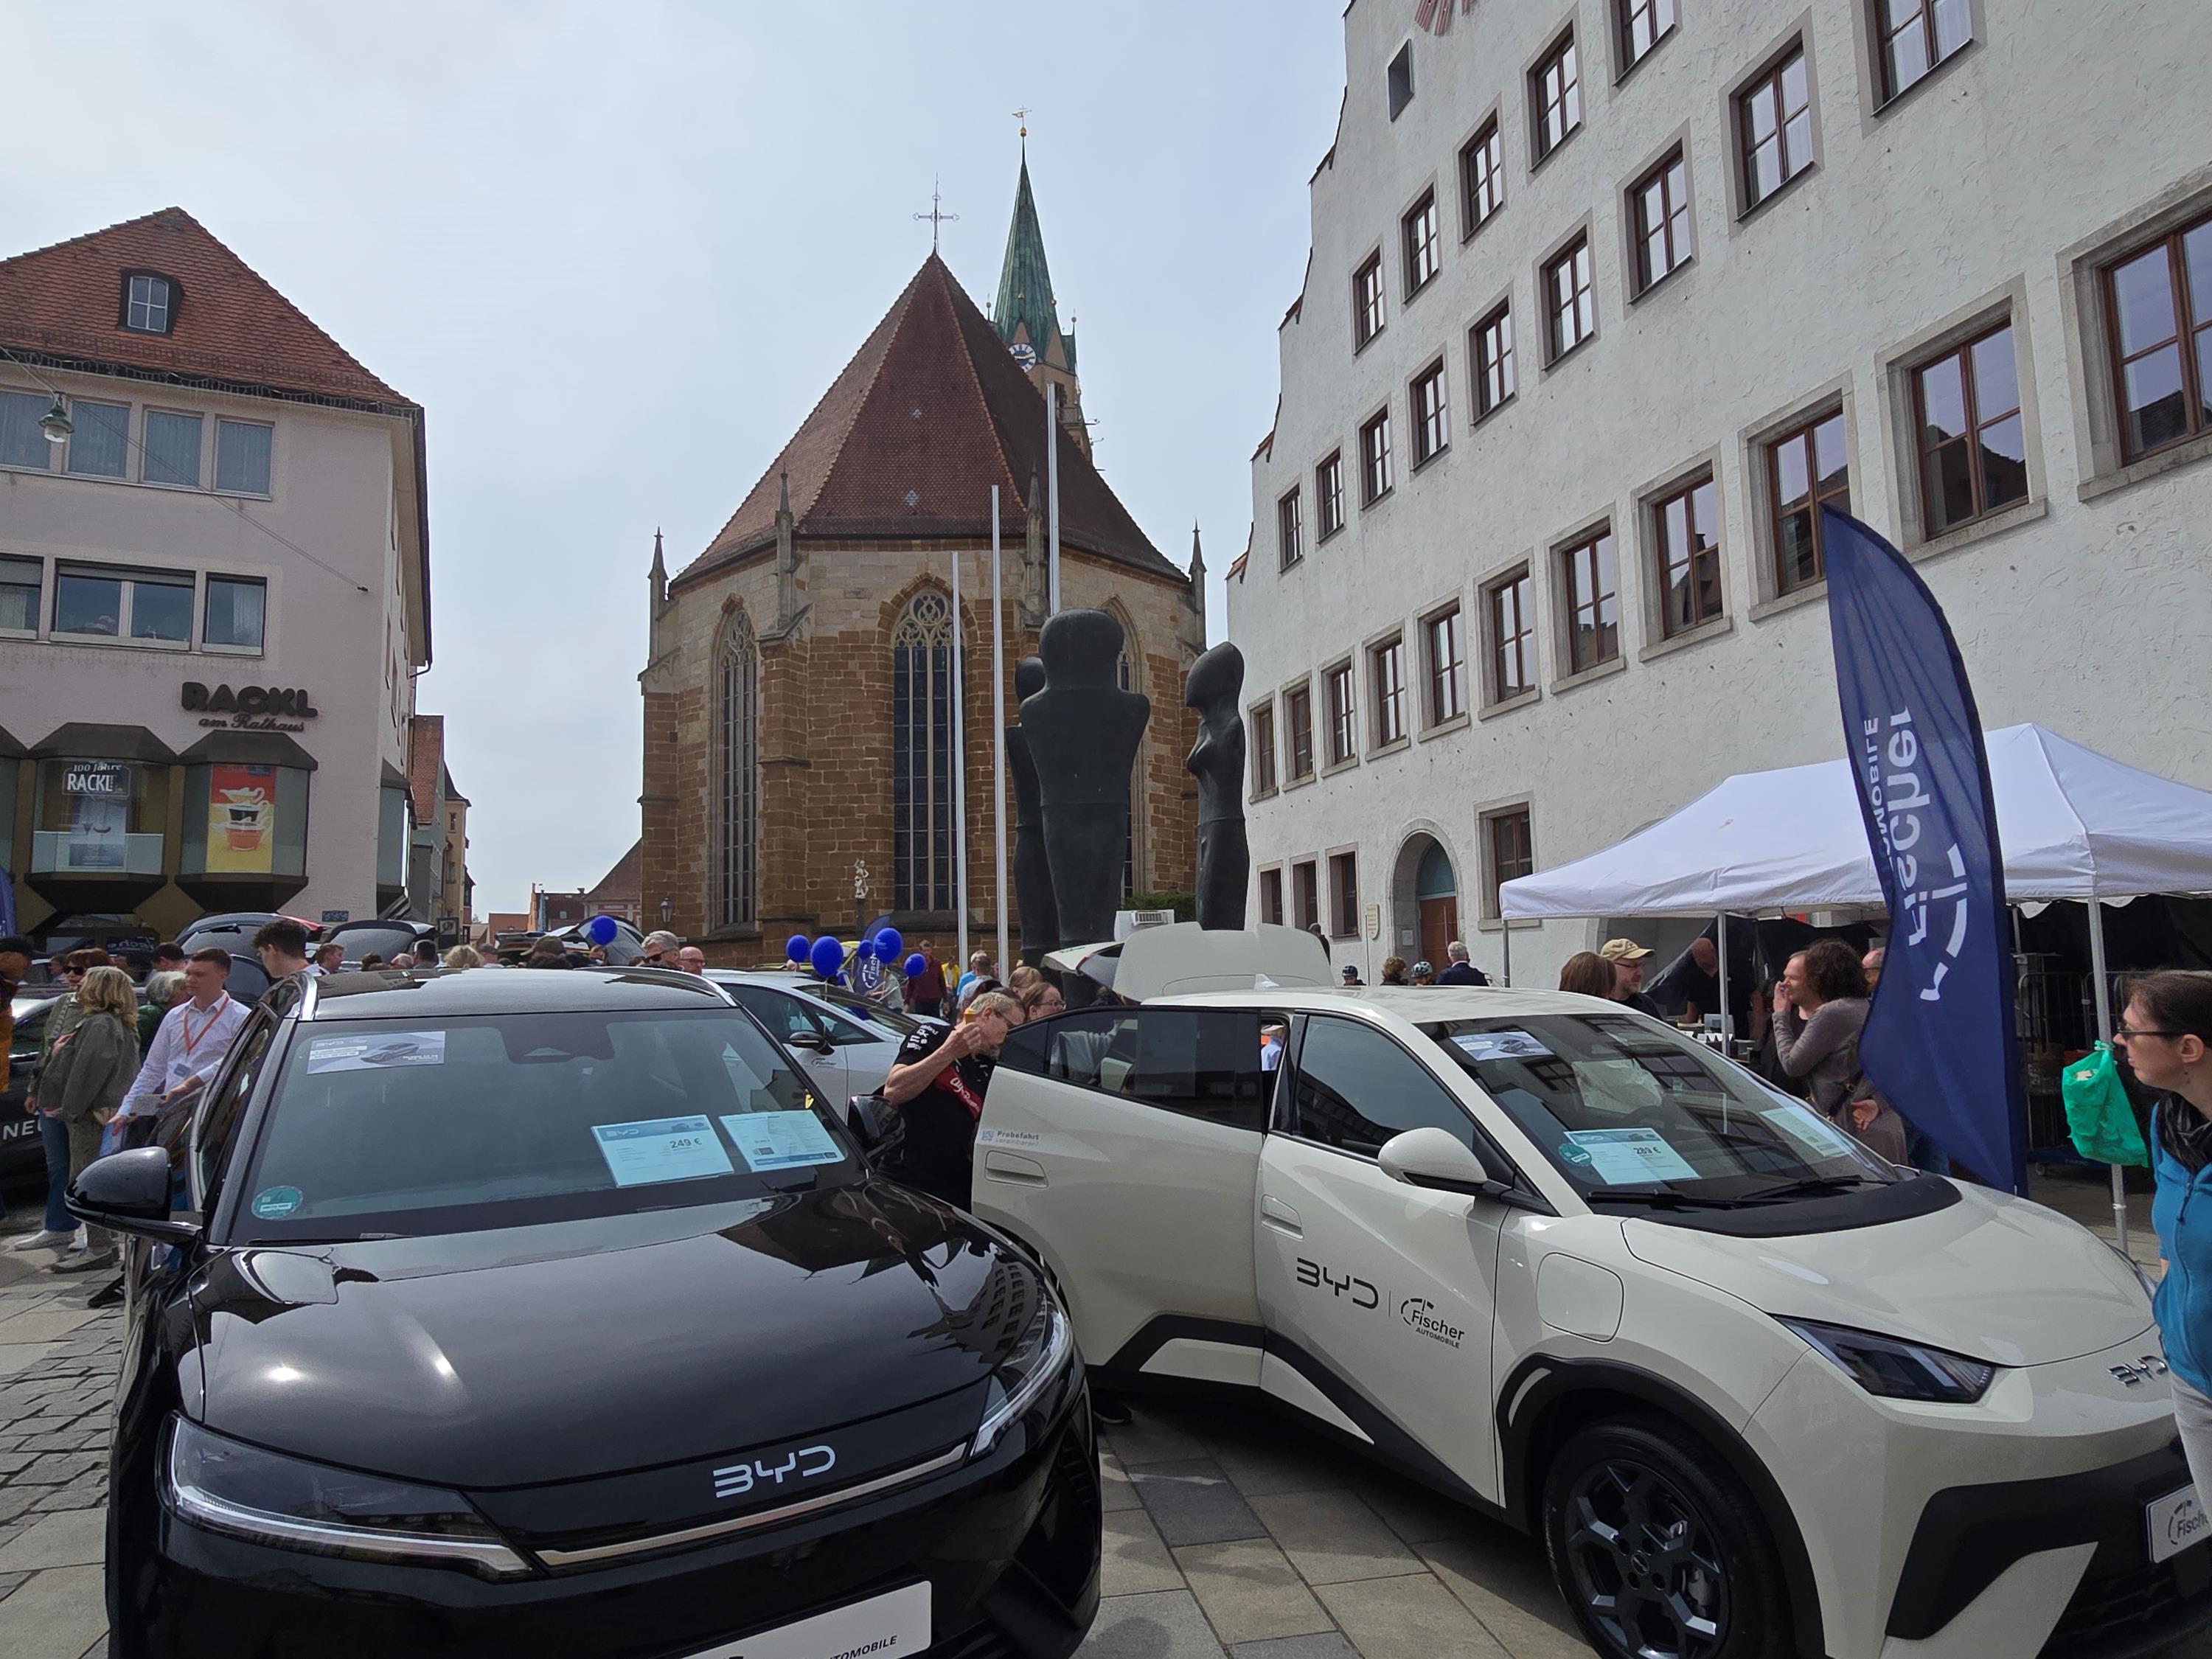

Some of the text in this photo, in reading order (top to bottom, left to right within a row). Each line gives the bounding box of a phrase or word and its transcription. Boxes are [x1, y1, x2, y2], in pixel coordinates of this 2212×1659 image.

[181, 681, 318, 717] RACKL
[198, 713, 305, 732] am Rathaus
[74, 764, 90, 772] 100
[669, 1138, 692, 1149] 249
[997, 1130, 1039, 1141] Probefahrt
[1297, 1256, 1379, 1310] BYD
[1411, 1310, 1465, 1340] Fischer
[1416, 1326, 1460, 1349] AUTOMOBILE
[2107, 1355, 2168, 1387] BYD
[713, 1444, 836, 1498] BYD
[2177, 1509, 2209, 1539] Fisch
[830, 1635, 897, 1659] TOMOBILE
